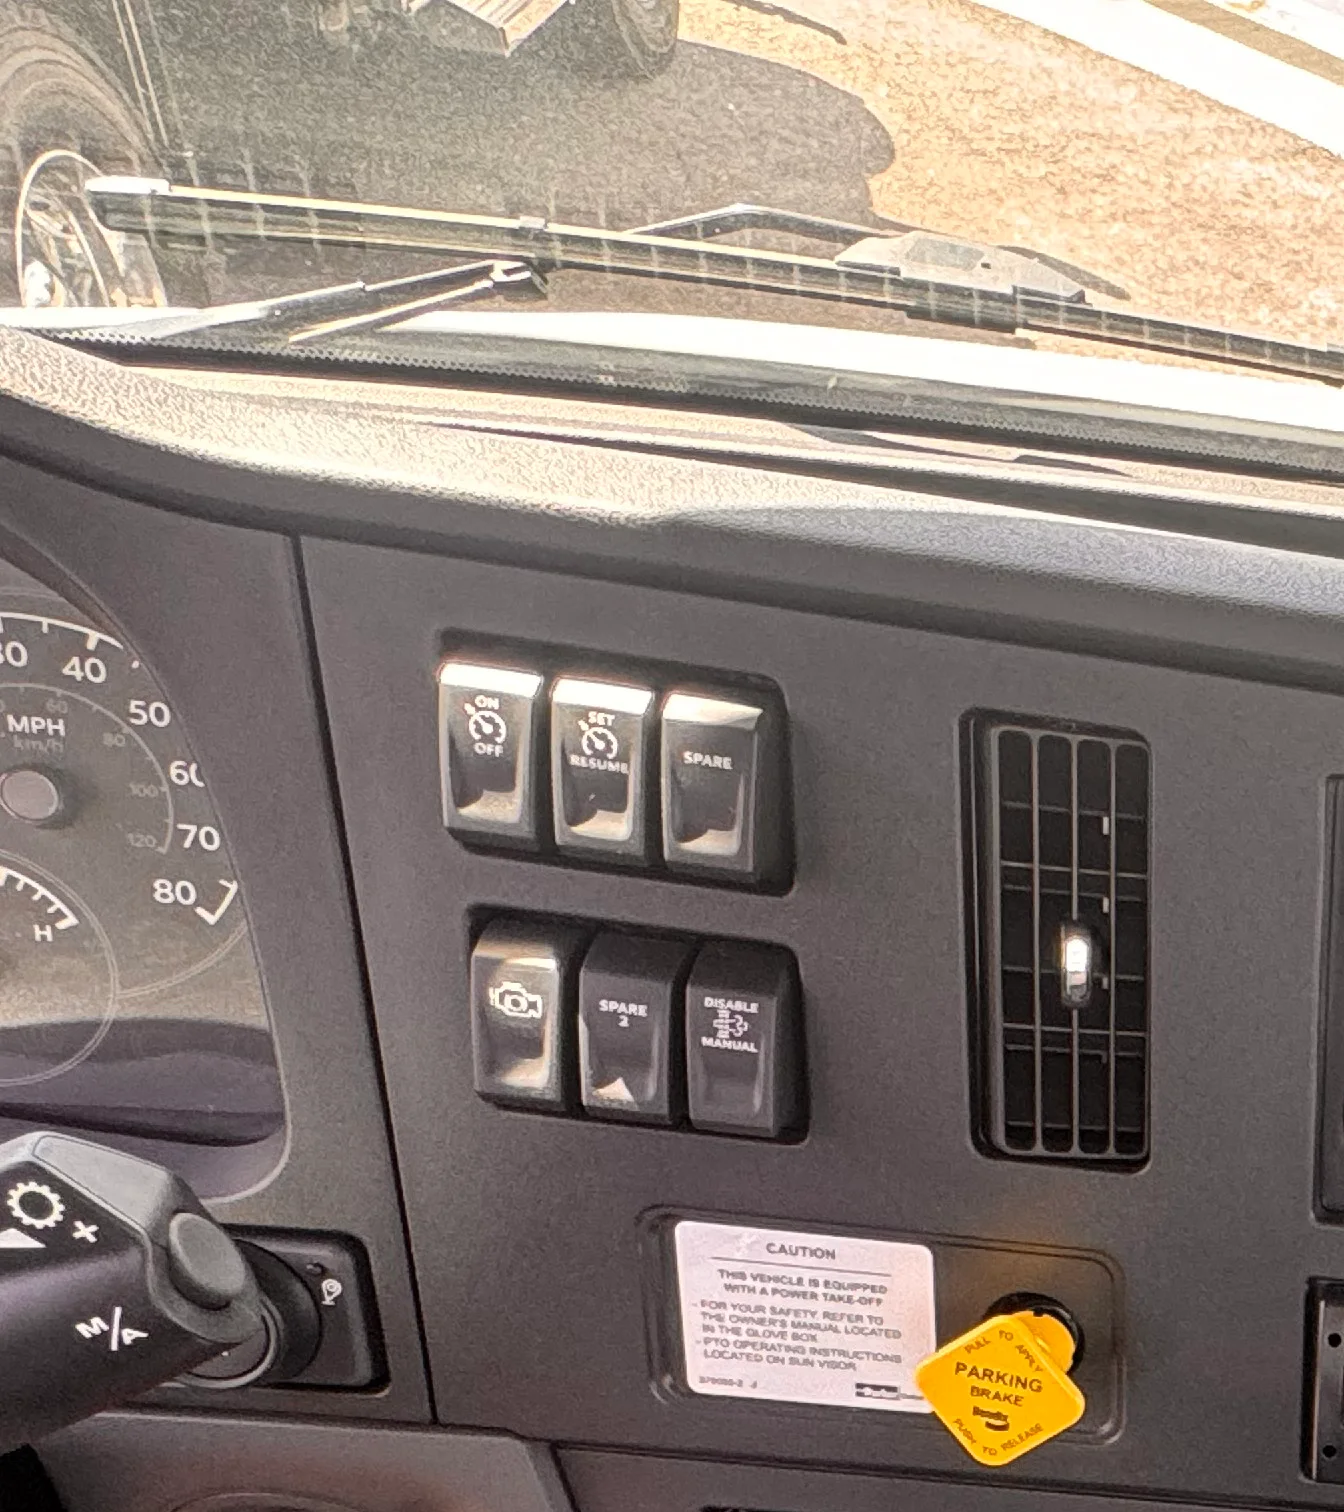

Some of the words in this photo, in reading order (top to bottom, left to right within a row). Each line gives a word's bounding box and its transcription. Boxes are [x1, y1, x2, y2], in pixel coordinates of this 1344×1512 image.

[0, 641, 28, 667] 0
[62, 656, 107, 684] 40
[128, 700, 171, 728] 50
[474, 695, 500, 710] ON
[7, 714, 66, 737] MPH
[588, 711, 615, 727] SET
[474, 743, 504, 758] OFF
[684, 750, 732, 771] SPARE
[569, 755, 629, 774] RESUME
[127, 833, 156, 848] 120
[177, 825, 220, 852] 70
[153, 879, 197, 905] 80
[34, 925, 53, 942] H
[599, 999, 648, 1017] SPARE
[703, 996, 759, 1013] DISABLE
[701, 1037, 758, 1053] MANUAL
[766, 1243, 836, 1260] CAUTION
[718, 1269, 747, 1281] THIS
[750, 1272, 804, 1287] VEHICLE
[808, 1278, 820, 1288] IS
[823, 1280, 888, 1295] EQUIPPED
[724, 1283, 756, 1295] WITH
[760, 1286, 769, 1296] A
[771, 1287, 819, 1301] POWER
[822, 1292, 884, 1307] TAKE-OFF
[700, 1299, 727, 1310] FOR
[731, 1303, 767, 1315] YOUR
[822, 1311, 864, 1324] REFER
[866, 1315, 884, 1326] TO
[701, 1311, 725, 1323] THE
[729, 1314, 788, 1329] OWNER'S
[791, 1320, 842, 1334] MANUAL
[845, 1325, 903, 1340] LOCATED
[702, 1324, 716, 1334] IN
[719, 1325, 742, 1337] THE
[746, 1328, 788, 1341] GLOVE
[791, 1331, 818, 1343] BOX
[704, 1337, 730, 1348] PTO
[733, 1339, 806, 1355] OPERATING
[809, 1346, 902, 1364] INSTRUCTIONS
[704, 1348, 763, 1363] LOCATED
[766, 1354, 785, 1366] ON
[788, 1356, 815, 1368] SUN
[817, 1359, 857, 1372] VISOR
[964, 1336, 991, 1354] PULL
[999, 1330, 1014, 1341] TO
[1015, 1344, 1043, 1373] APPLY
[954, 1361, 1043, 1393] PARKING
[970, 1385, 1024, 1407] BRAKE
[982, 1446, 997, 1456] TO
[1000, 1423, 1044, 1451] RELEASE
